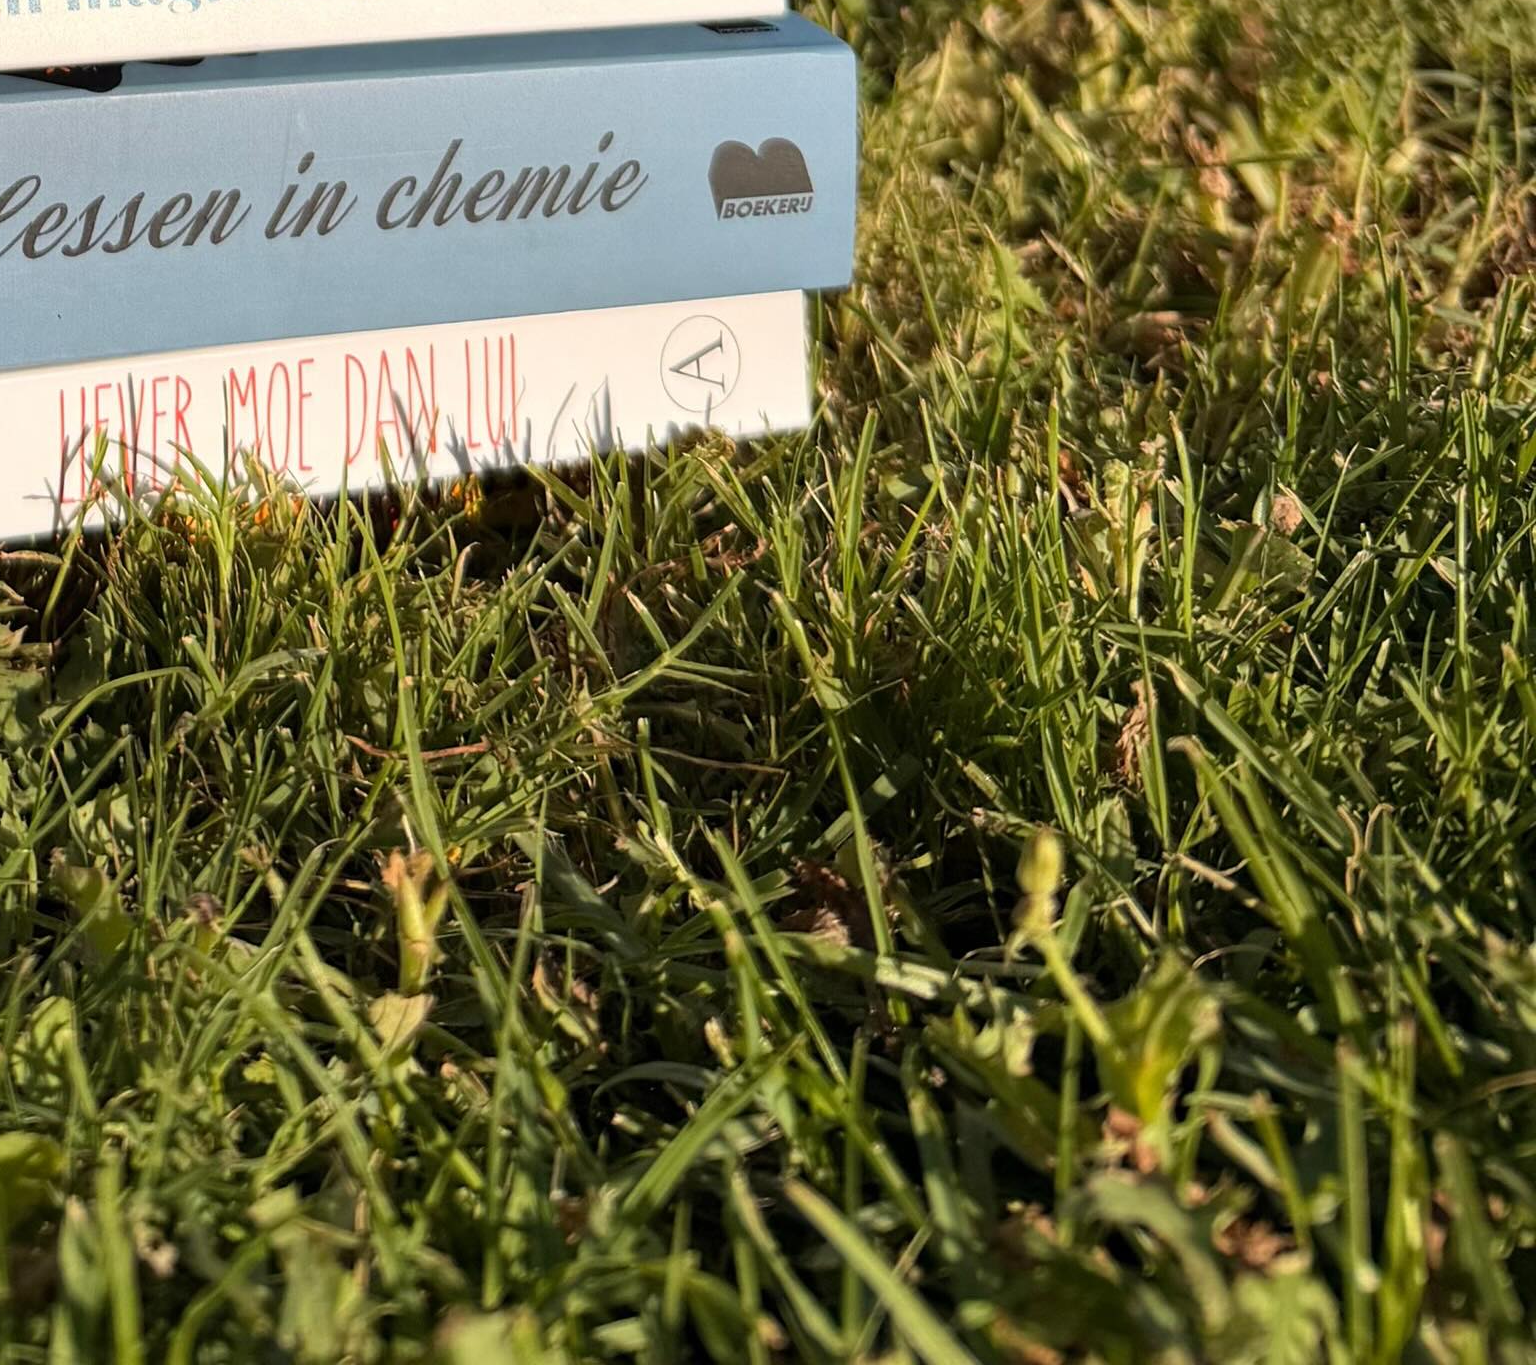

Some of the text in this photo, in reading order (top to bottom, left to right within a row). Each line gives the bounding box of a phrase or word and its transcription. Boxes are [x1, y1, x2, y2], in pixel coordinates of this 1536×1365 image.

[264, 151, 358, 240] in
[375, 130, 650, 229] chemie
[59, 331, 518, 504] LIEVER MOE DAN LUI
